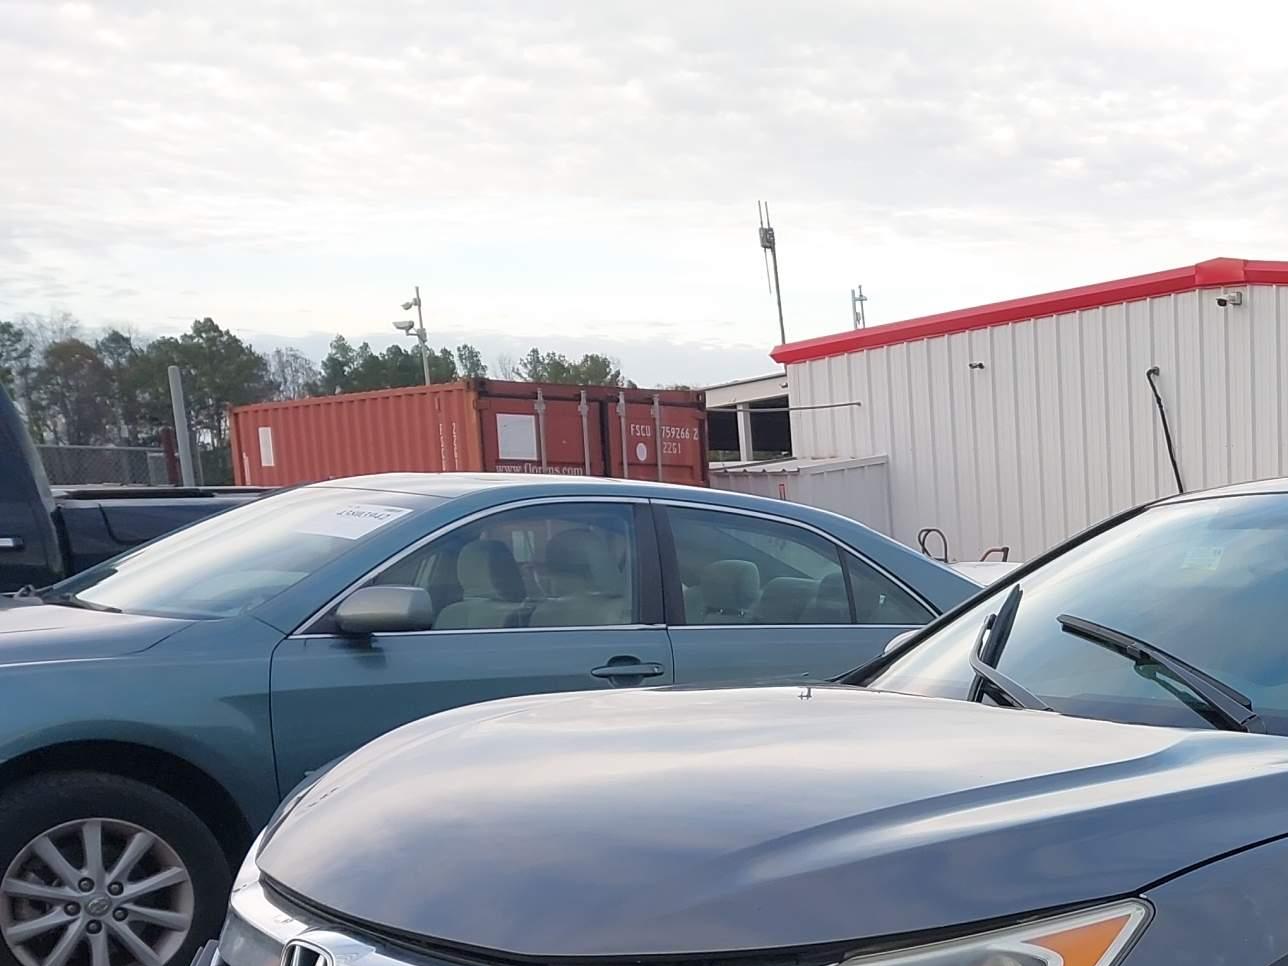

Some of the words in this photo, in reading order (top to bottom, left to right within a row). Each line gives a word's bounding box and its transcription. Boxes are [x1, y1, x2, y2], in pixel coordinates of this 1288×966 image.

[630, 424, 651, 437] FSCU
[661, 426, 690, 439] 759266
[693, 428, 699, 440] 2
